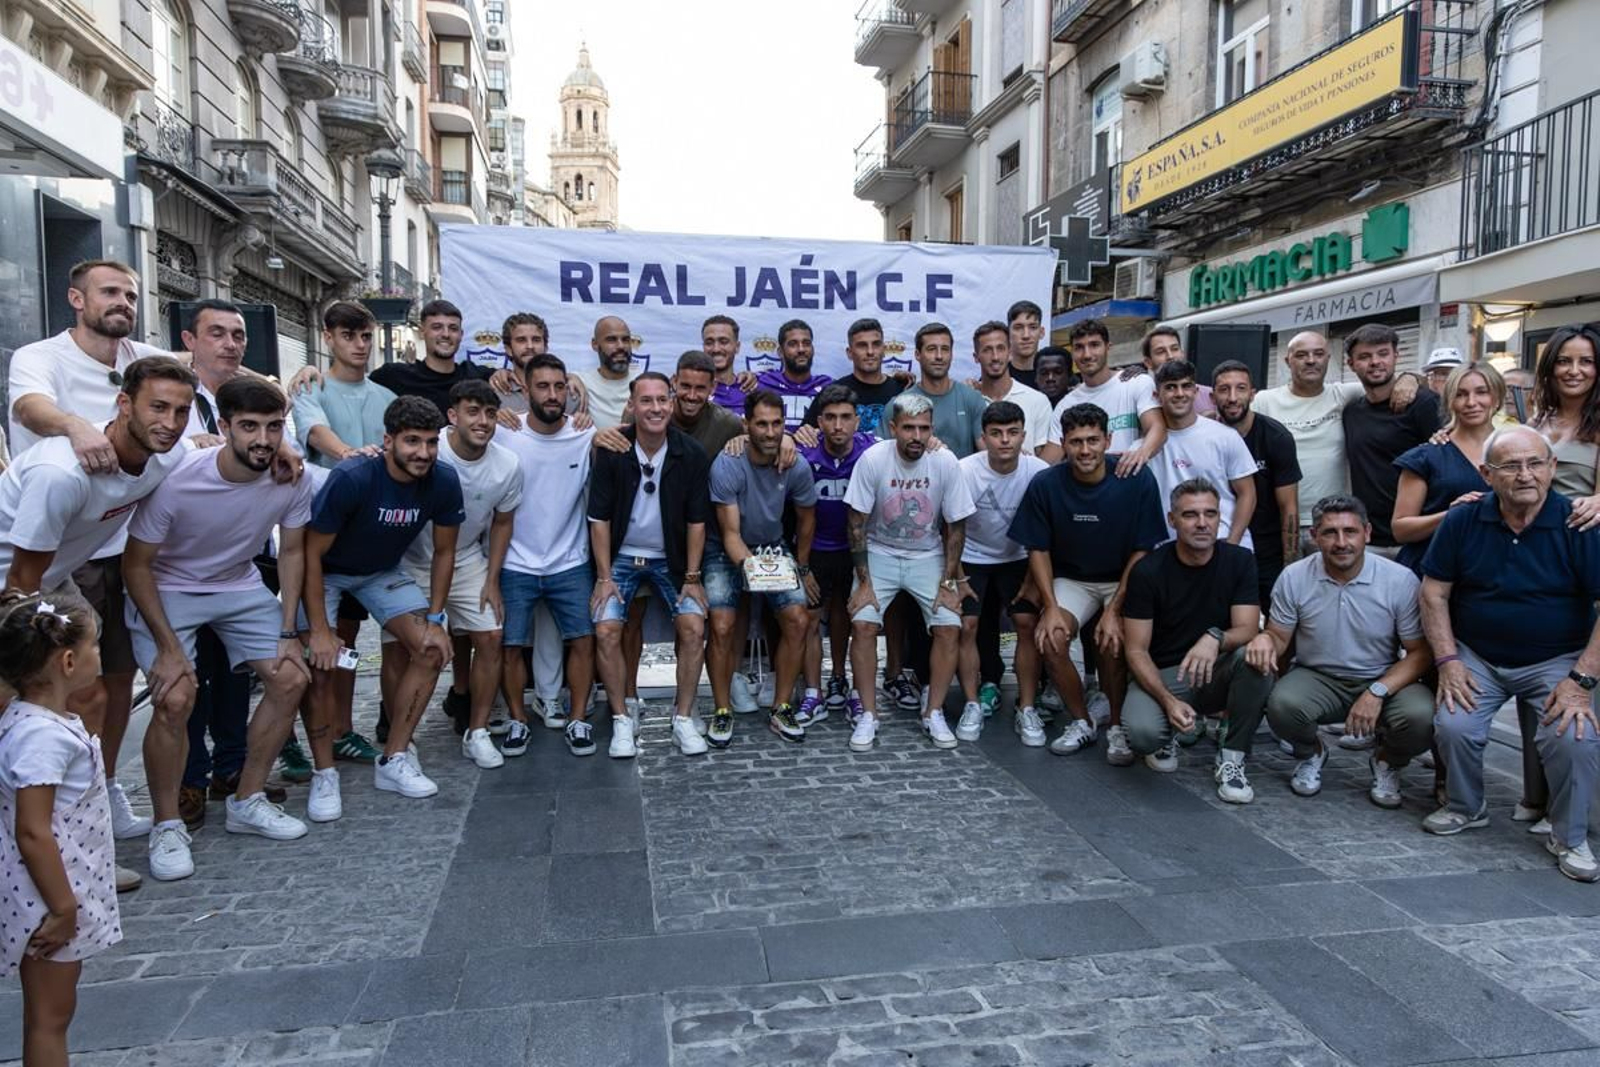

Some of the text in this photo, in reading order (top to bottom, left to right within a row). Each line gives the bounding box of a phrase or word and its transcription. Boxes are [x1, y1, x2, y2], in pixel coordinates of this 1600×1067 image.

[1253, 114, 1286, 135] SEGUROS
[1287, 109, 1298, 119] DE
[1327, 70, 1377, 99] PENSIONES
[1282, 80, 1330, 106] NACIONAL
[1331, 70, 1346, 84] DE
[1347, 42, 1396, 73] SEGUROS
[559, 254, 953, 313] REAL JAÉN C.F
[1189, 231, 1352, 308] FARMACIA
[1293, 287, 1397, 323] FARMACIA
[378, 507, 420, 523] TOMMY
